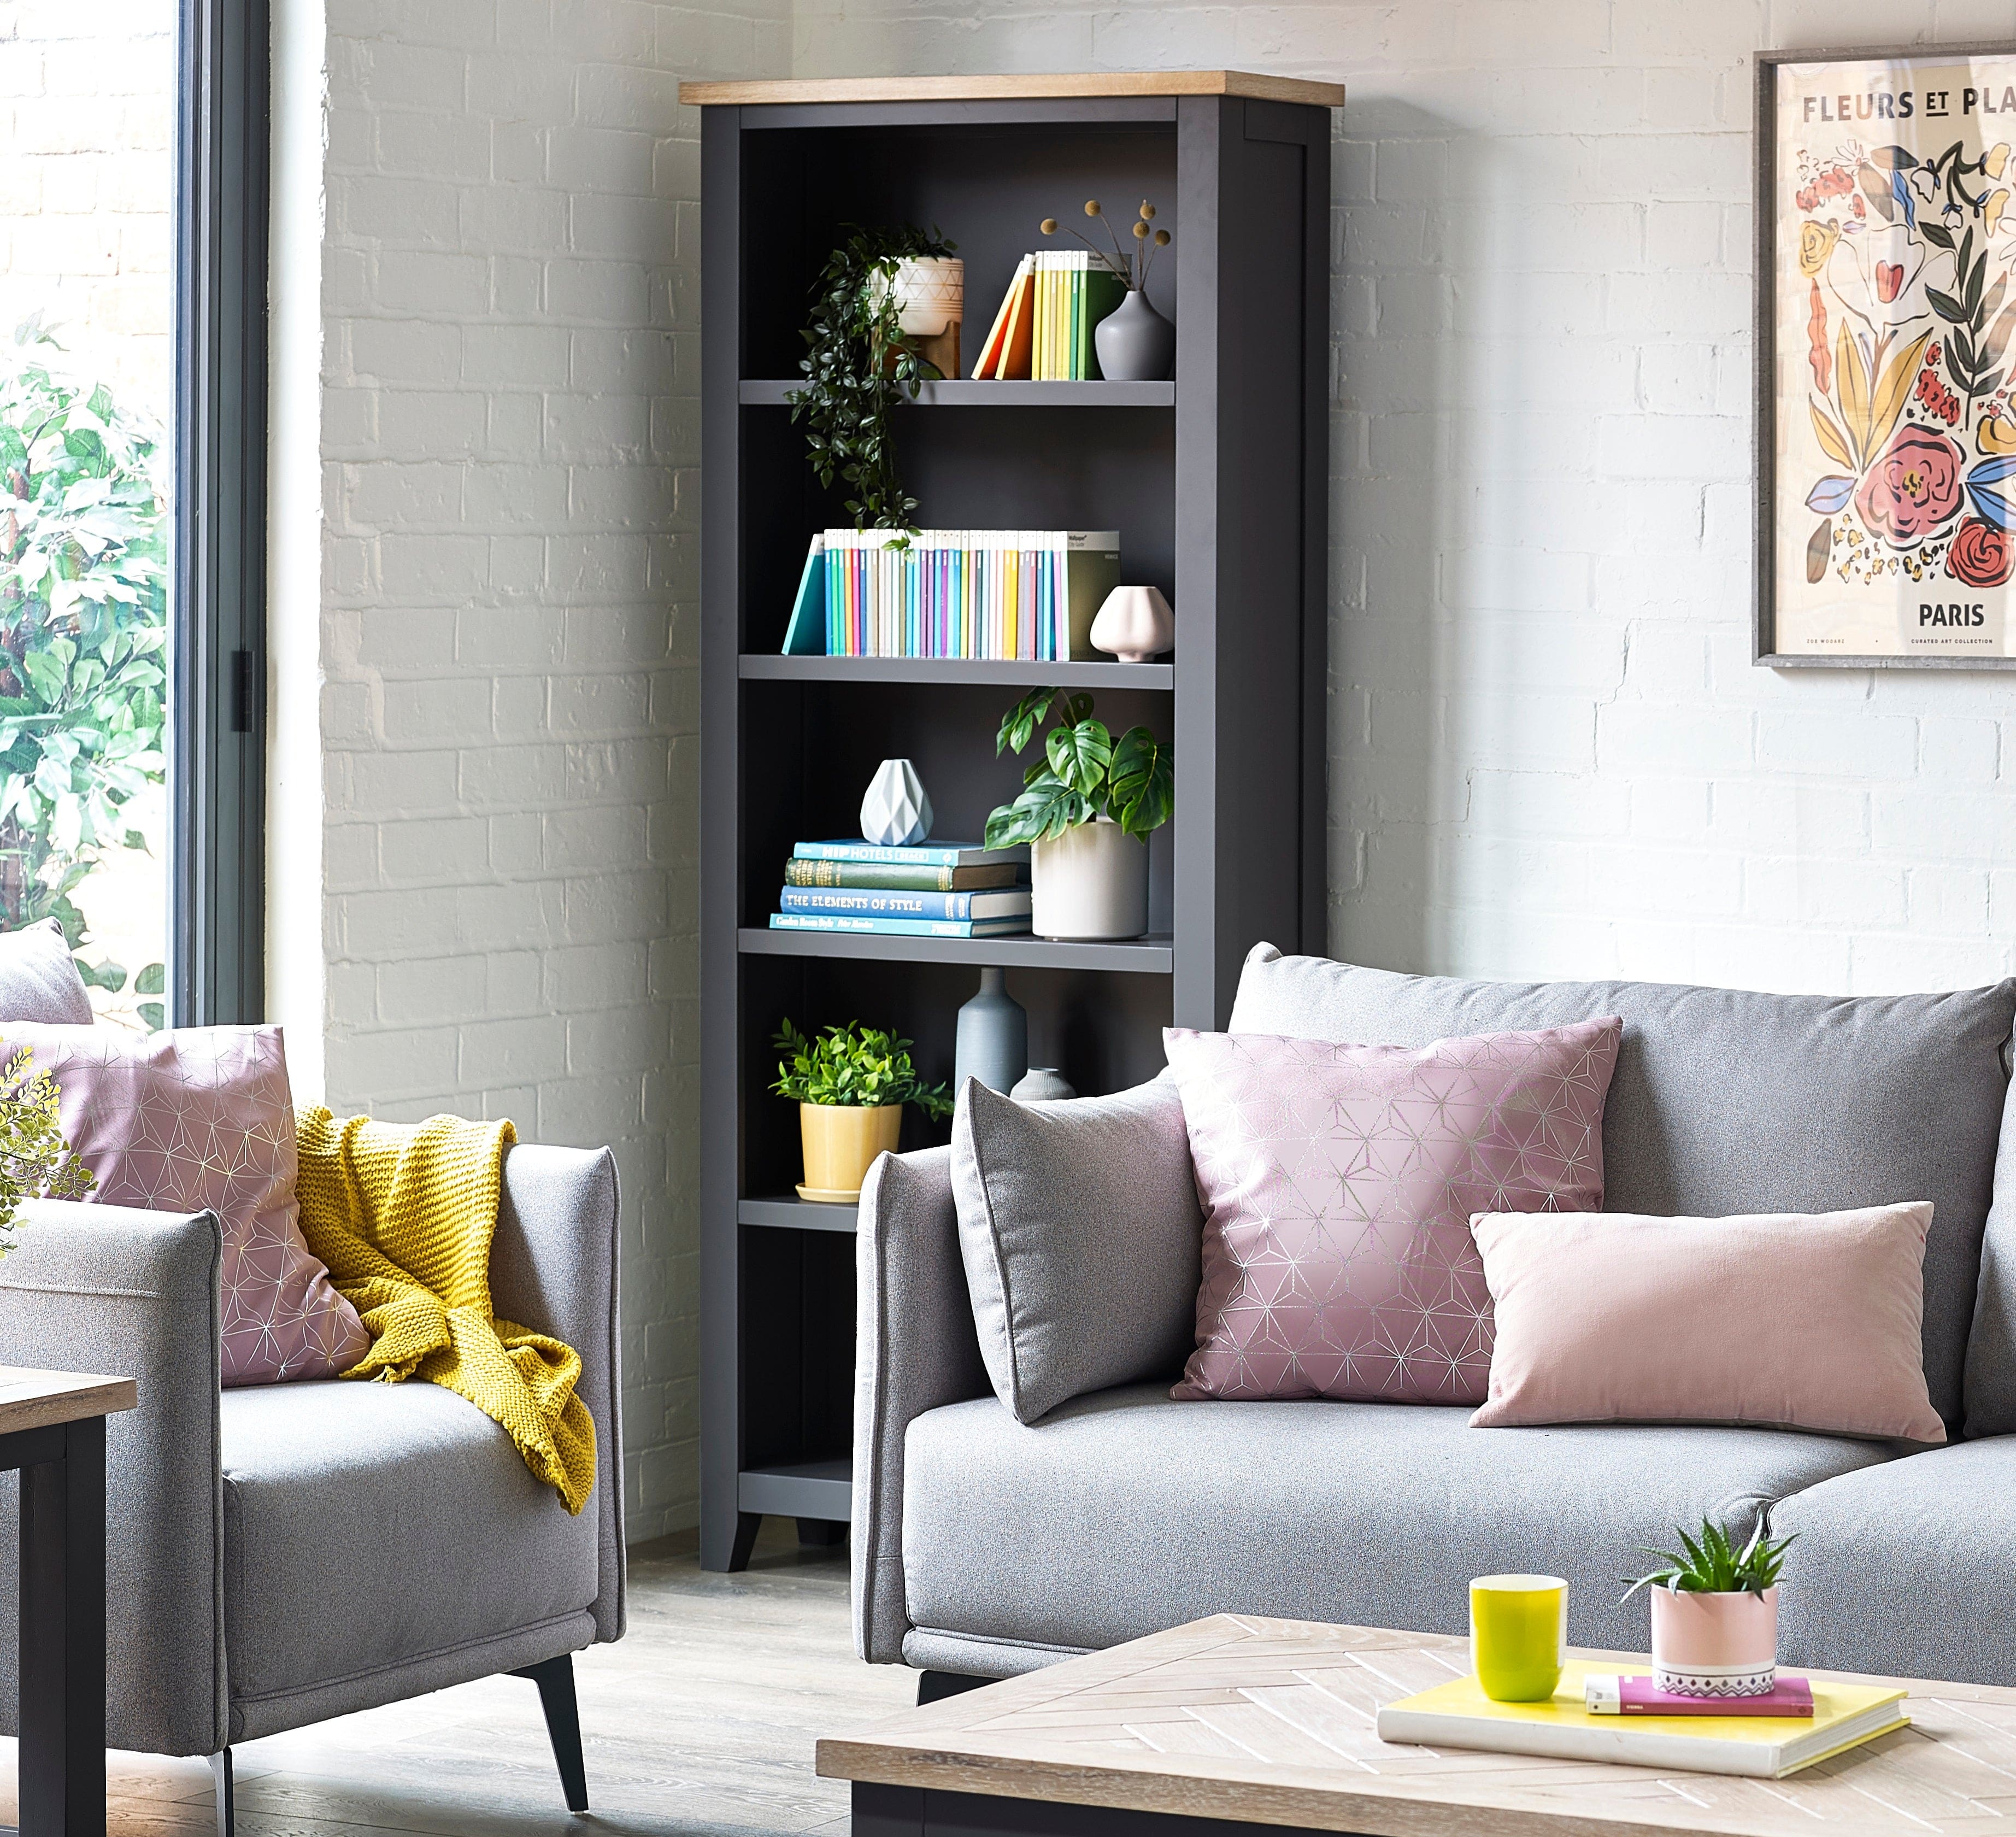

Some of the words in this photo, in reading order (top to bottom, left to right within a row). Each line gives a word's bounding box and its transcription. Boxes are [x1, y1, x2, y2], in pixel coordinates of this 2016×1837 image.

[1803, 91, 1914, 123] FLEURS
[1925, 91, 1949, 110] ET
[1963, 86, 2016, 115] PLA
[1919, 603, 1985, 627] PARIS
[821, 847, 850, 858] HIP
[850, 848, 894, 860] HOTELS
[786, 895, 809, 907] THE
[812, 896, 868, 908] ELEMENTS
[871, 898, 887, 910] OF
[889, 899, 923, 912] STYLE
